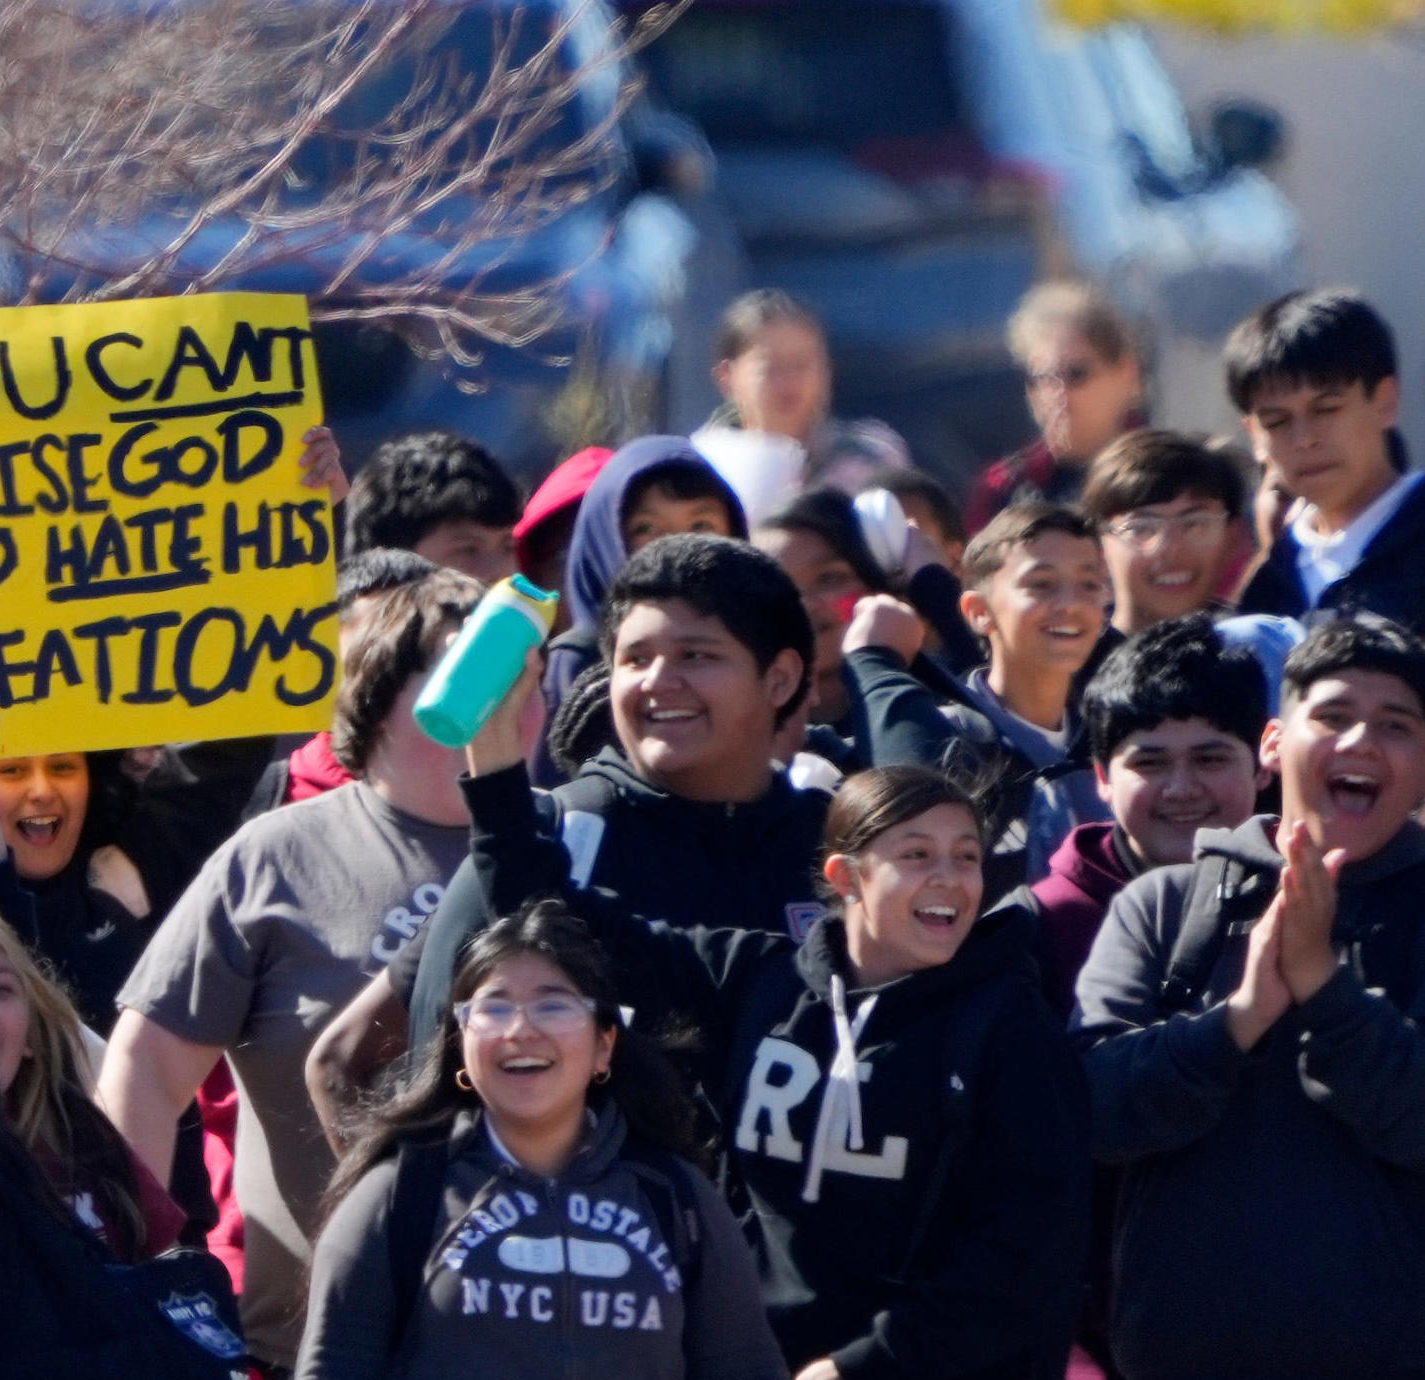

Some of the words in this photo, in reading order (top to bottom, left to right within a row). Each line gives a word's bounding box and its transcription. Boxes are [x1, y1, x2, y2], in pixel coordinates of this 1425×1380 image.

[87, 322, 313, 402] CANT
[46, 504, 209, 588] HATE
[221, 501, 328, 573] HIS
[372, 883, 446, 963] CRO
[462, 1277, 554, 1322] NYC
[580, 1290, 664, 1331] USA
